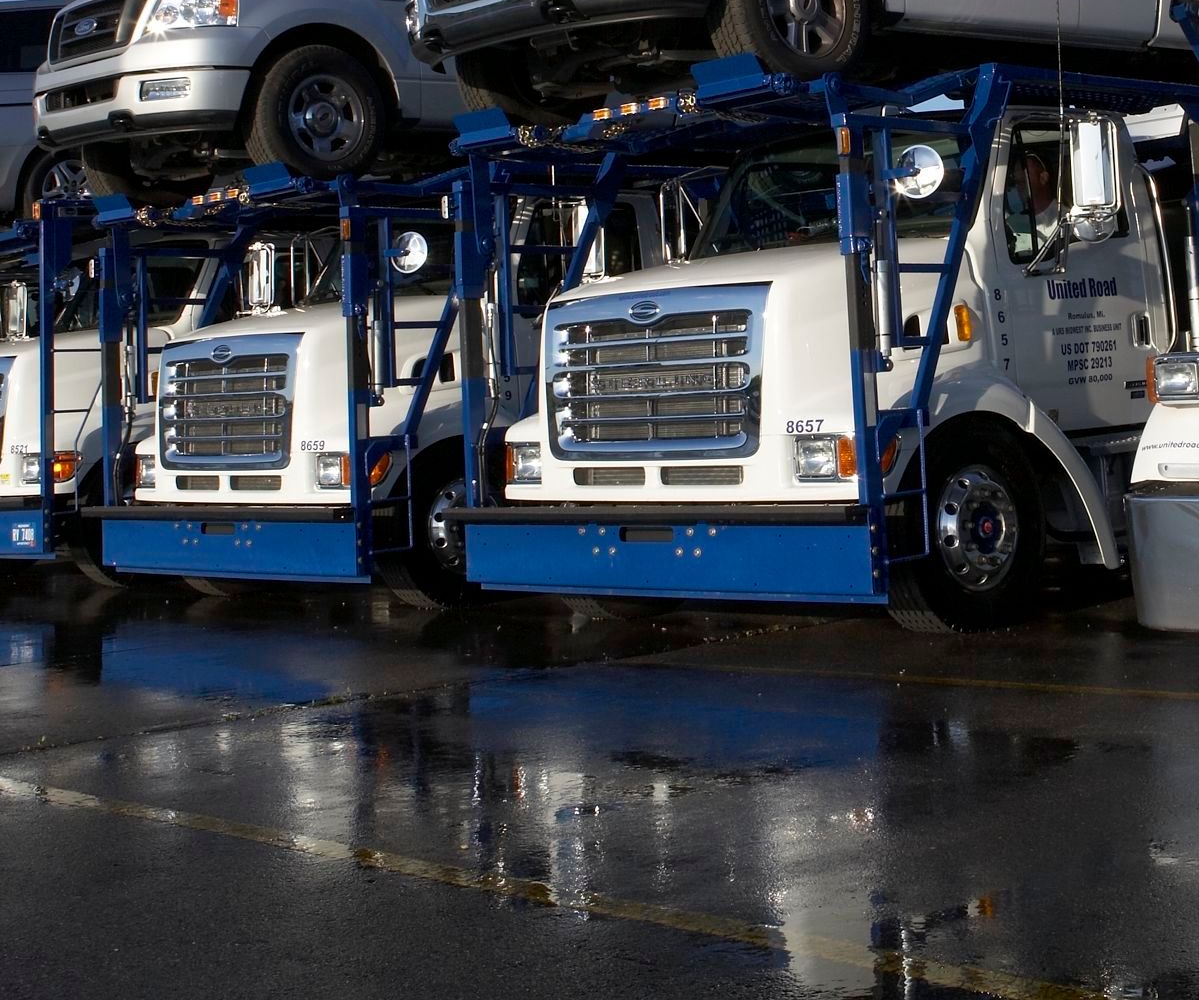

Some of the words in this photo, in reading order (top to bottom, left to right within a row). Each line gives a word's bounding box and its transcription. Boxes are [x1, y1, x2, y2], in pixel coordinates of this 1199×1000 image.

[1047, 278, 1087, 300] United
[1088, 277, 1118, 298] Road
[1112, 322, 1122, 331] UNIT
[1061, 343, 1072, 355] US
[1074, 342, 1089, 354] DOT
[1091, 340, 1117, 353] 790261
[1067, 358, 1089, 371] MPSC
[1091, 356, 1113, 369] 29213
[1068, 376, 1086, 385] GVW
[1088, 373, 1113, 383] 80,000
[786, 419, 824, 434] 8657
[10, 444, 28, 455] 8521
[300, 440, 325, 451] 8659
